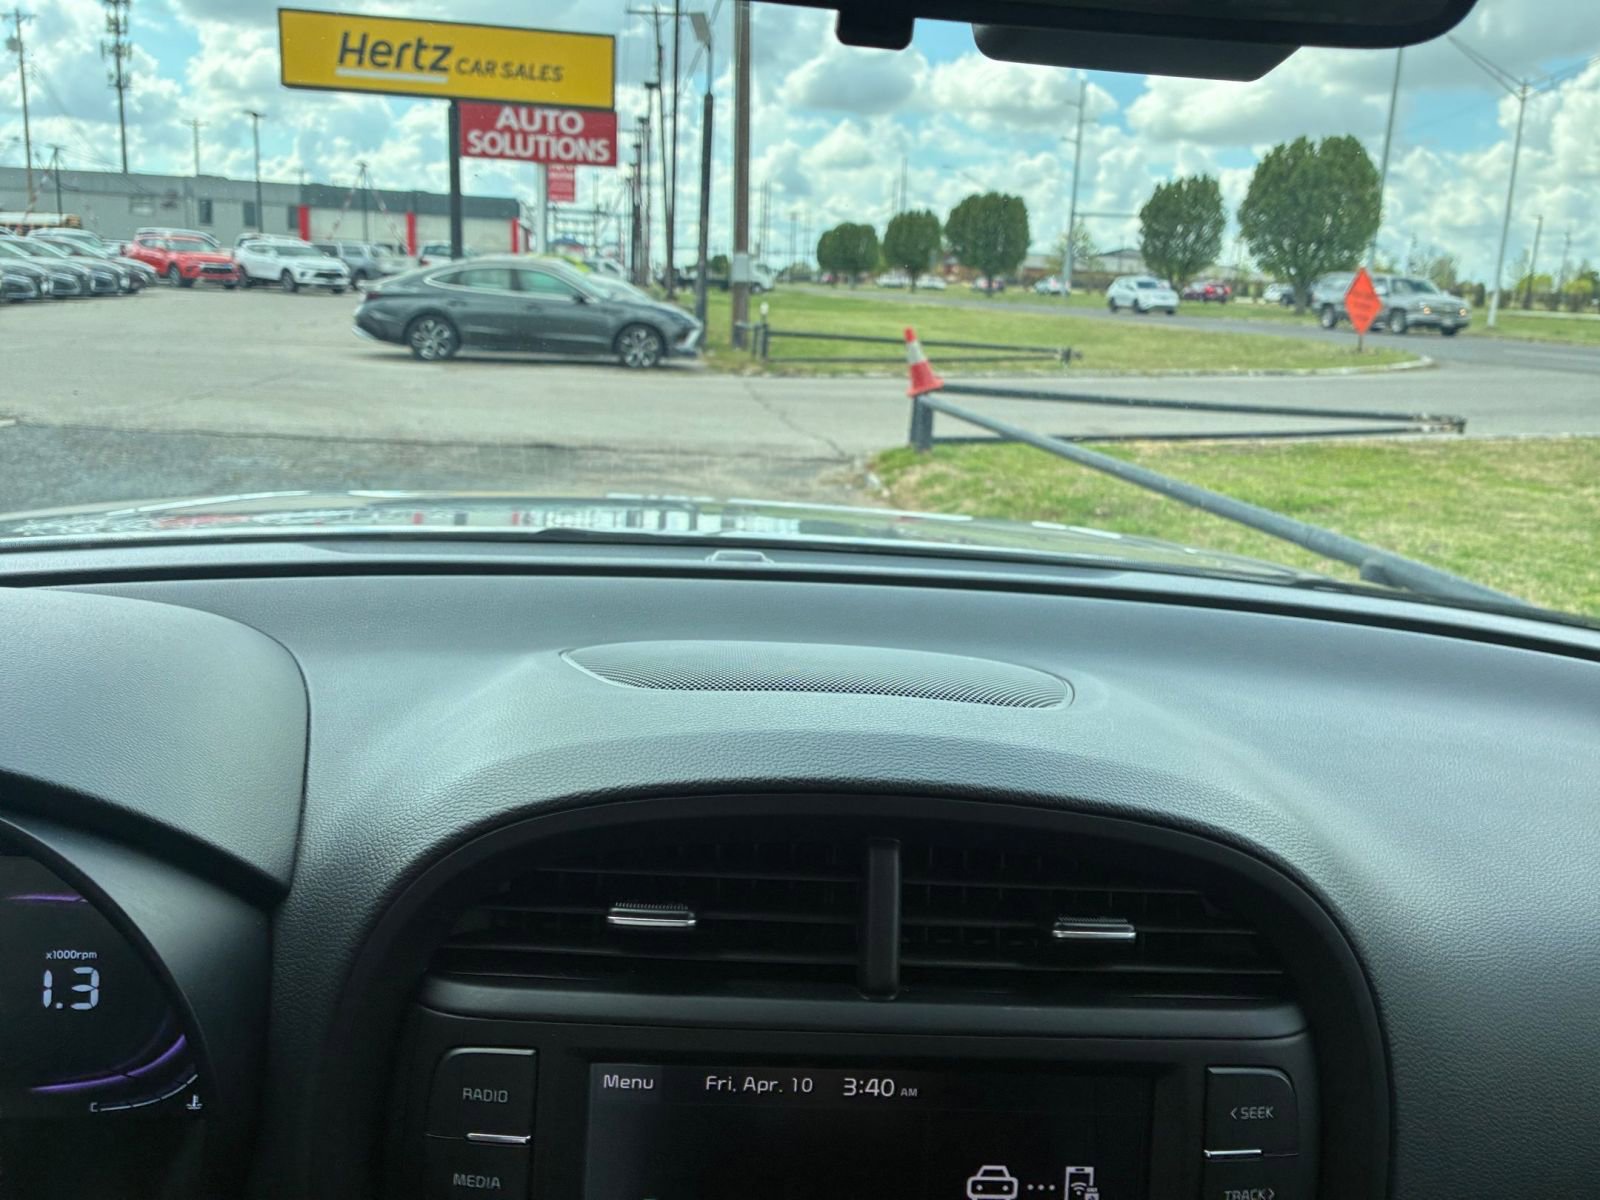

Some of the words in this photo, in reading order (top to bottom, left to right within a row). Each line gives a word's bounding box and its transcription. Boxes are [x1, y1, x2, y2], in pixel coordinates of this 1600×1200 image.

[338, 31, 454, 72] Hertz
[456, 58, 496, 78] CAR
[500, 61, 564, 82] SALES
[496, 107, 584, 134] AUTO
[468, 131, 609, 162] SOLUTIONS
[45, 950, 98, 960] x1000rpm
[43, 967, 99, 1010] 1.3
[462, 1087, 509, 1104] RADIO
[603, 1074, 654, 1089] Menu
[743, 1077, 783, 1095] Apr.
[791, 1077, 814, 1093] 10
[843, 1078, 895, 1097] 3:40
[901, 1087, 918, 1097] AM
[452, 1173, 502, 1190] MEDIA
